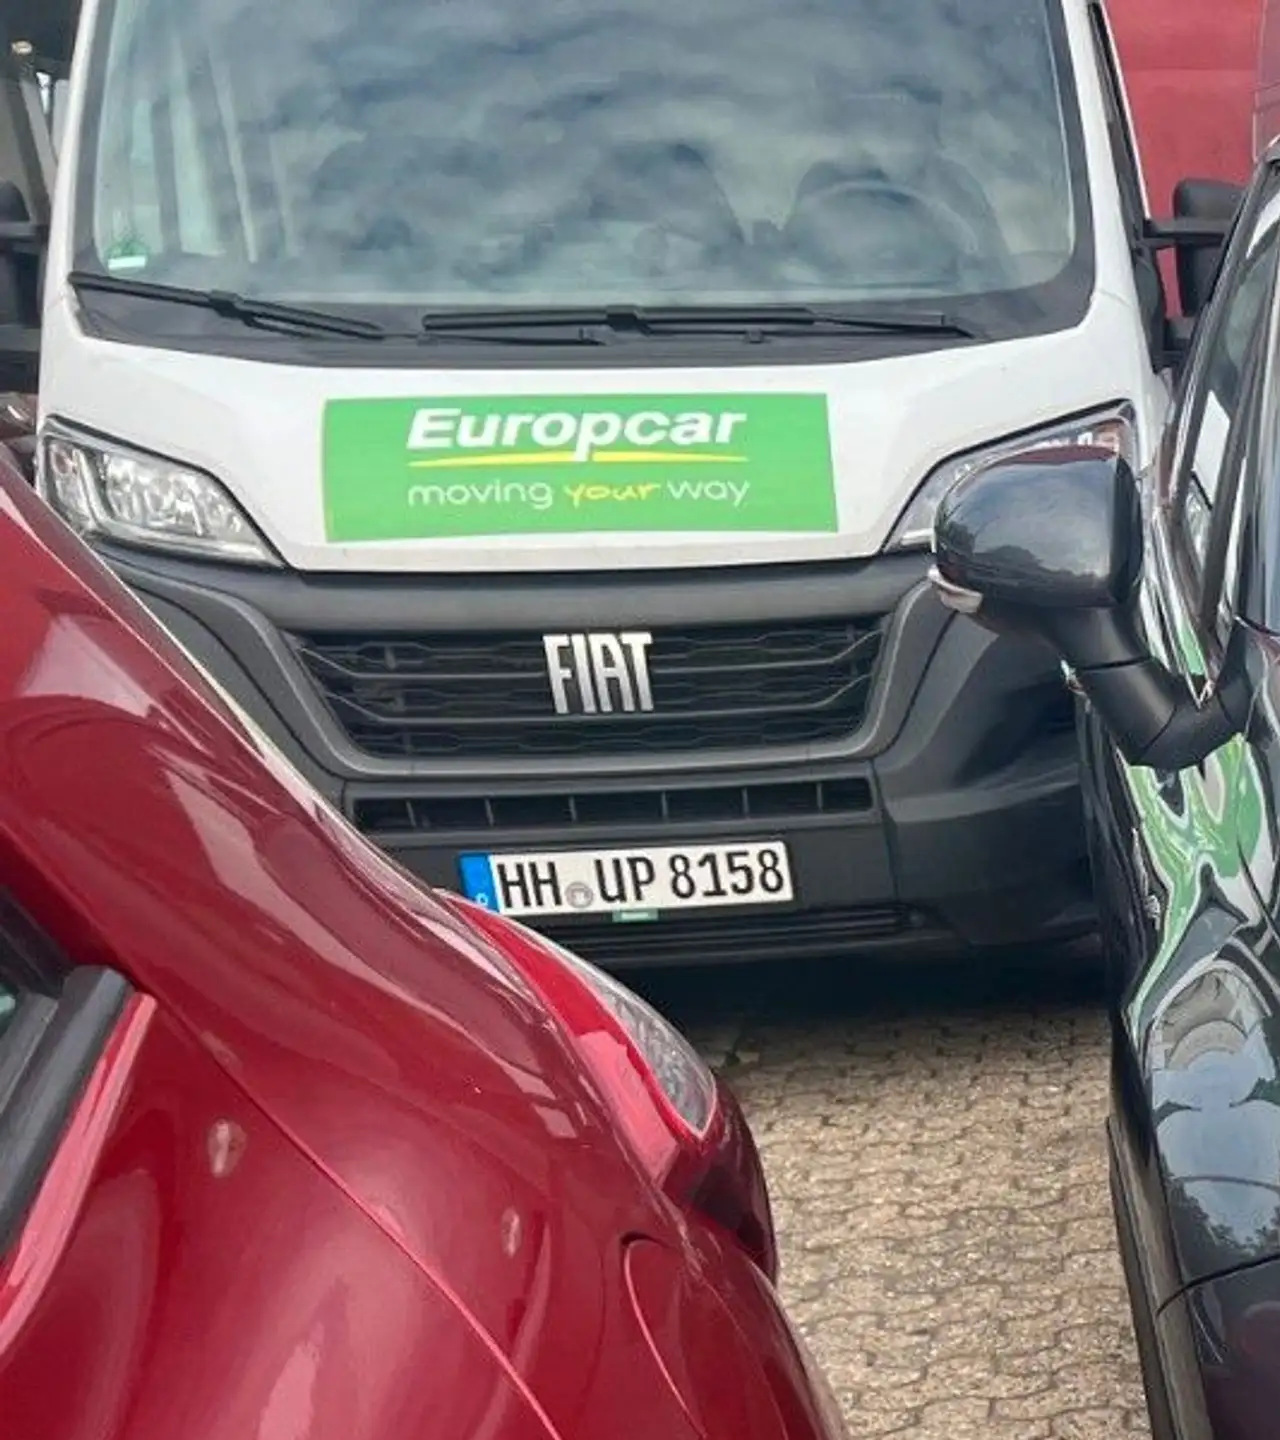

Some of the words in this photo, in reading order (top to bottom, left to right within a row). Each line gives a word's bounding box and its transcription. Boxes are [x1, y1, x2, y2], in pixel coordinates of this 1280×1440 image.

[406, 407, 746, 463] Europcar
[408, 479, 553, 511] moving
[565, 483, 661, 508] your
[666, 479, 750, 507] way
[542, 631, 654, 714] FIAT
[496, 861, 562, 909] HH
[594, 856, 655, 904] UP
[669, 849, 784, 899] 8158
